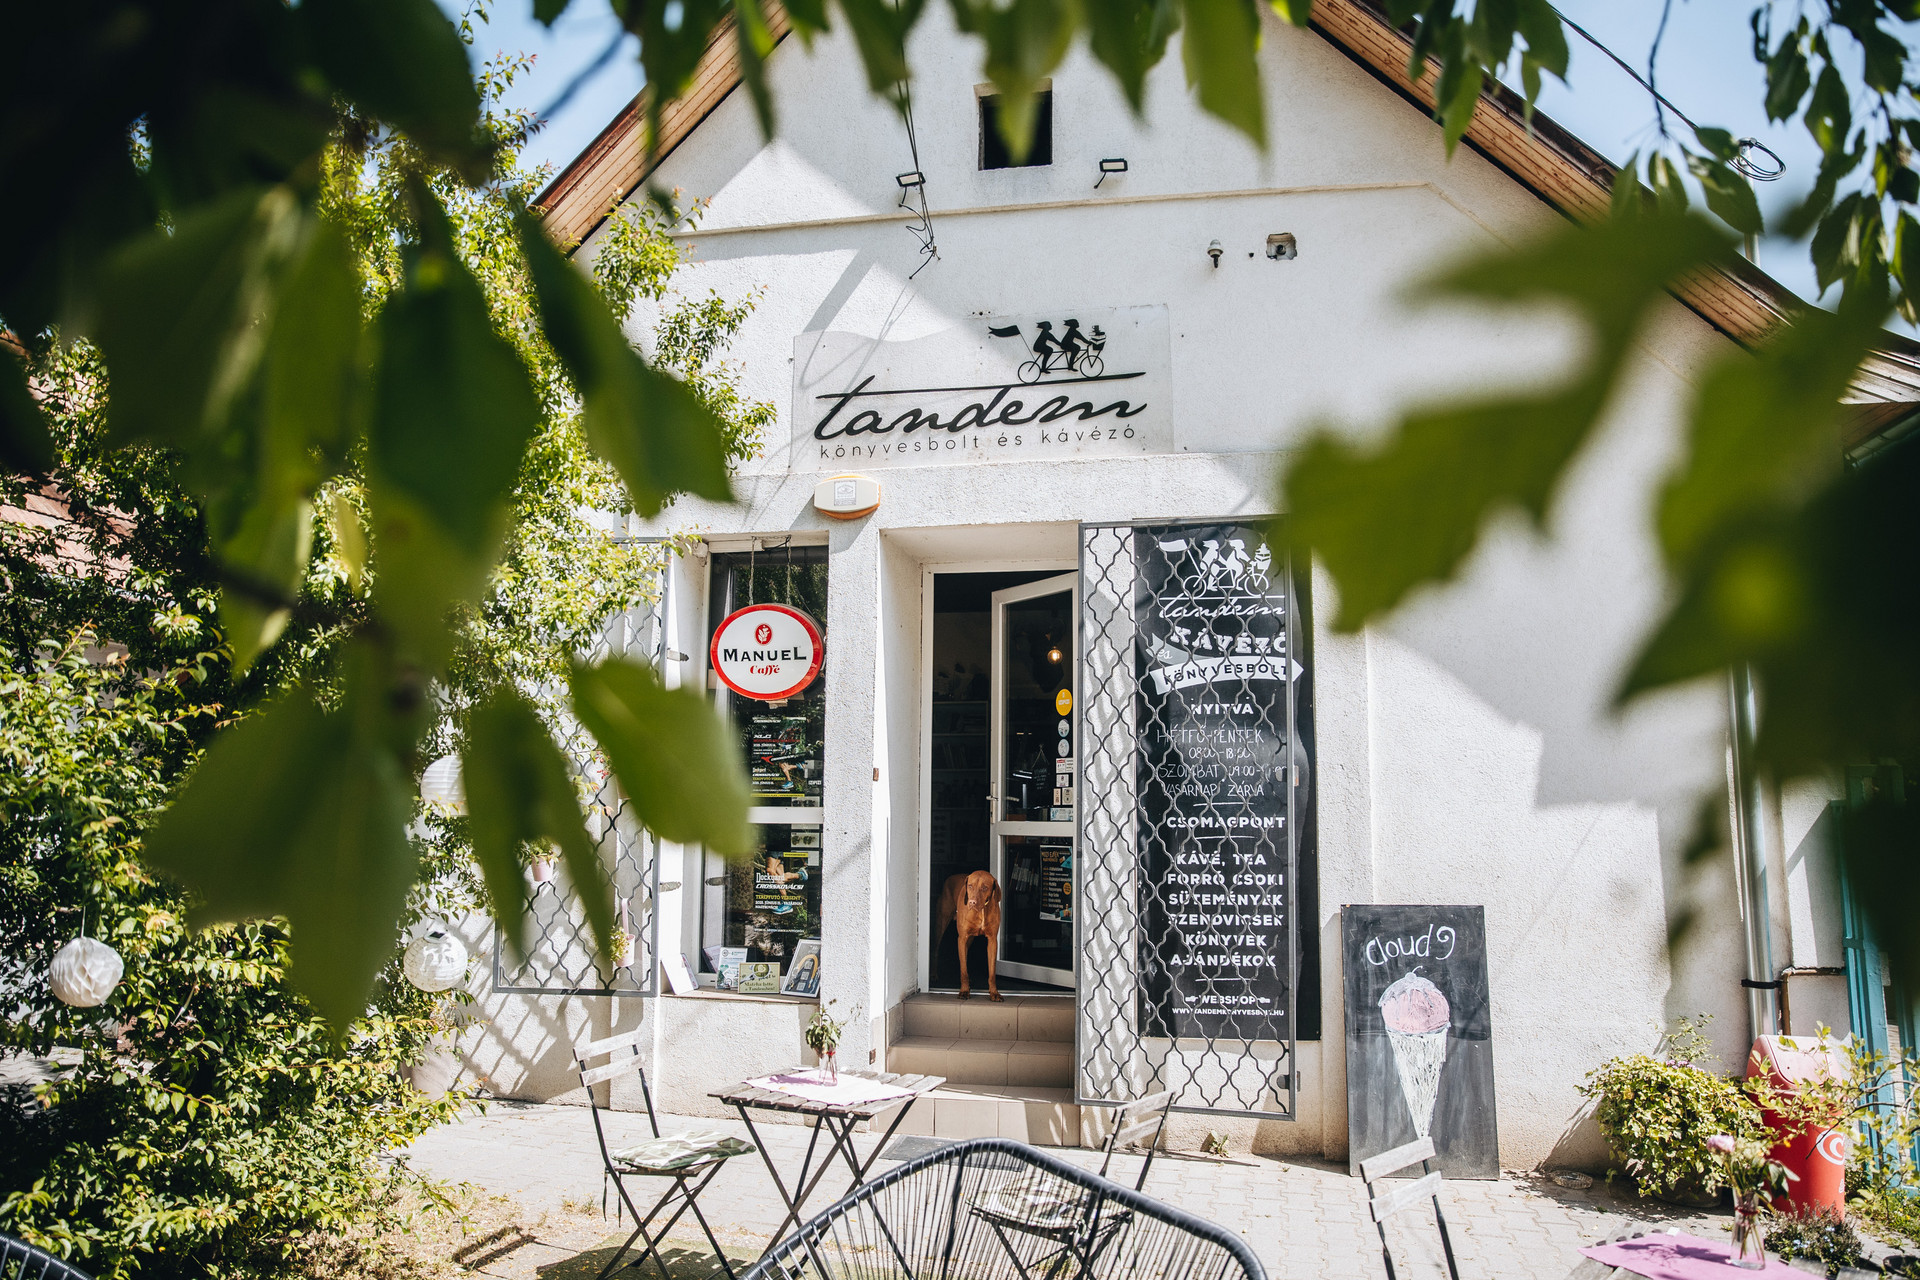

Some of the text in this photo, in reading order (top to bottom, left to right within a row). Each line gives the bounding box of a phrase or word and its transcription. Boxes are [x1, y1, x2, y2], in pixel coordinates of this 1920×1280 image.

[814, 374, 1148, 440] tandem
[820, 423, 1136, 460] könyvesbolt és kávézó
[1170, 626, 1286, 654] KÁVÉZÓ
[723, 646, 807, 662] MANUEL
[1164, 664, 1286, 686] KÖNYVESBOLT
[1190, 703, 1254, 715] NYITVA
[1227, 780, 1265, 797] ZÁRVA
[1166, 816, 1285, 828] CSOMAGPONT
[1176, 850, 1267, 867] KÁVÉ, TEA
[1167, 870, 1284, 886] FORRÓ CSOKI
[1168, 890, 1284, 906] SÜTEMÉNYEK
[1168, 913, 1284, 926] SZENDVICSEK
[1185, 930, 1268, 947] KÖNYVEK
[1170, 951, 1277, 967] AJÁNDÉKOK
[1201, 995, 1256, 1005] WEBSHOP
